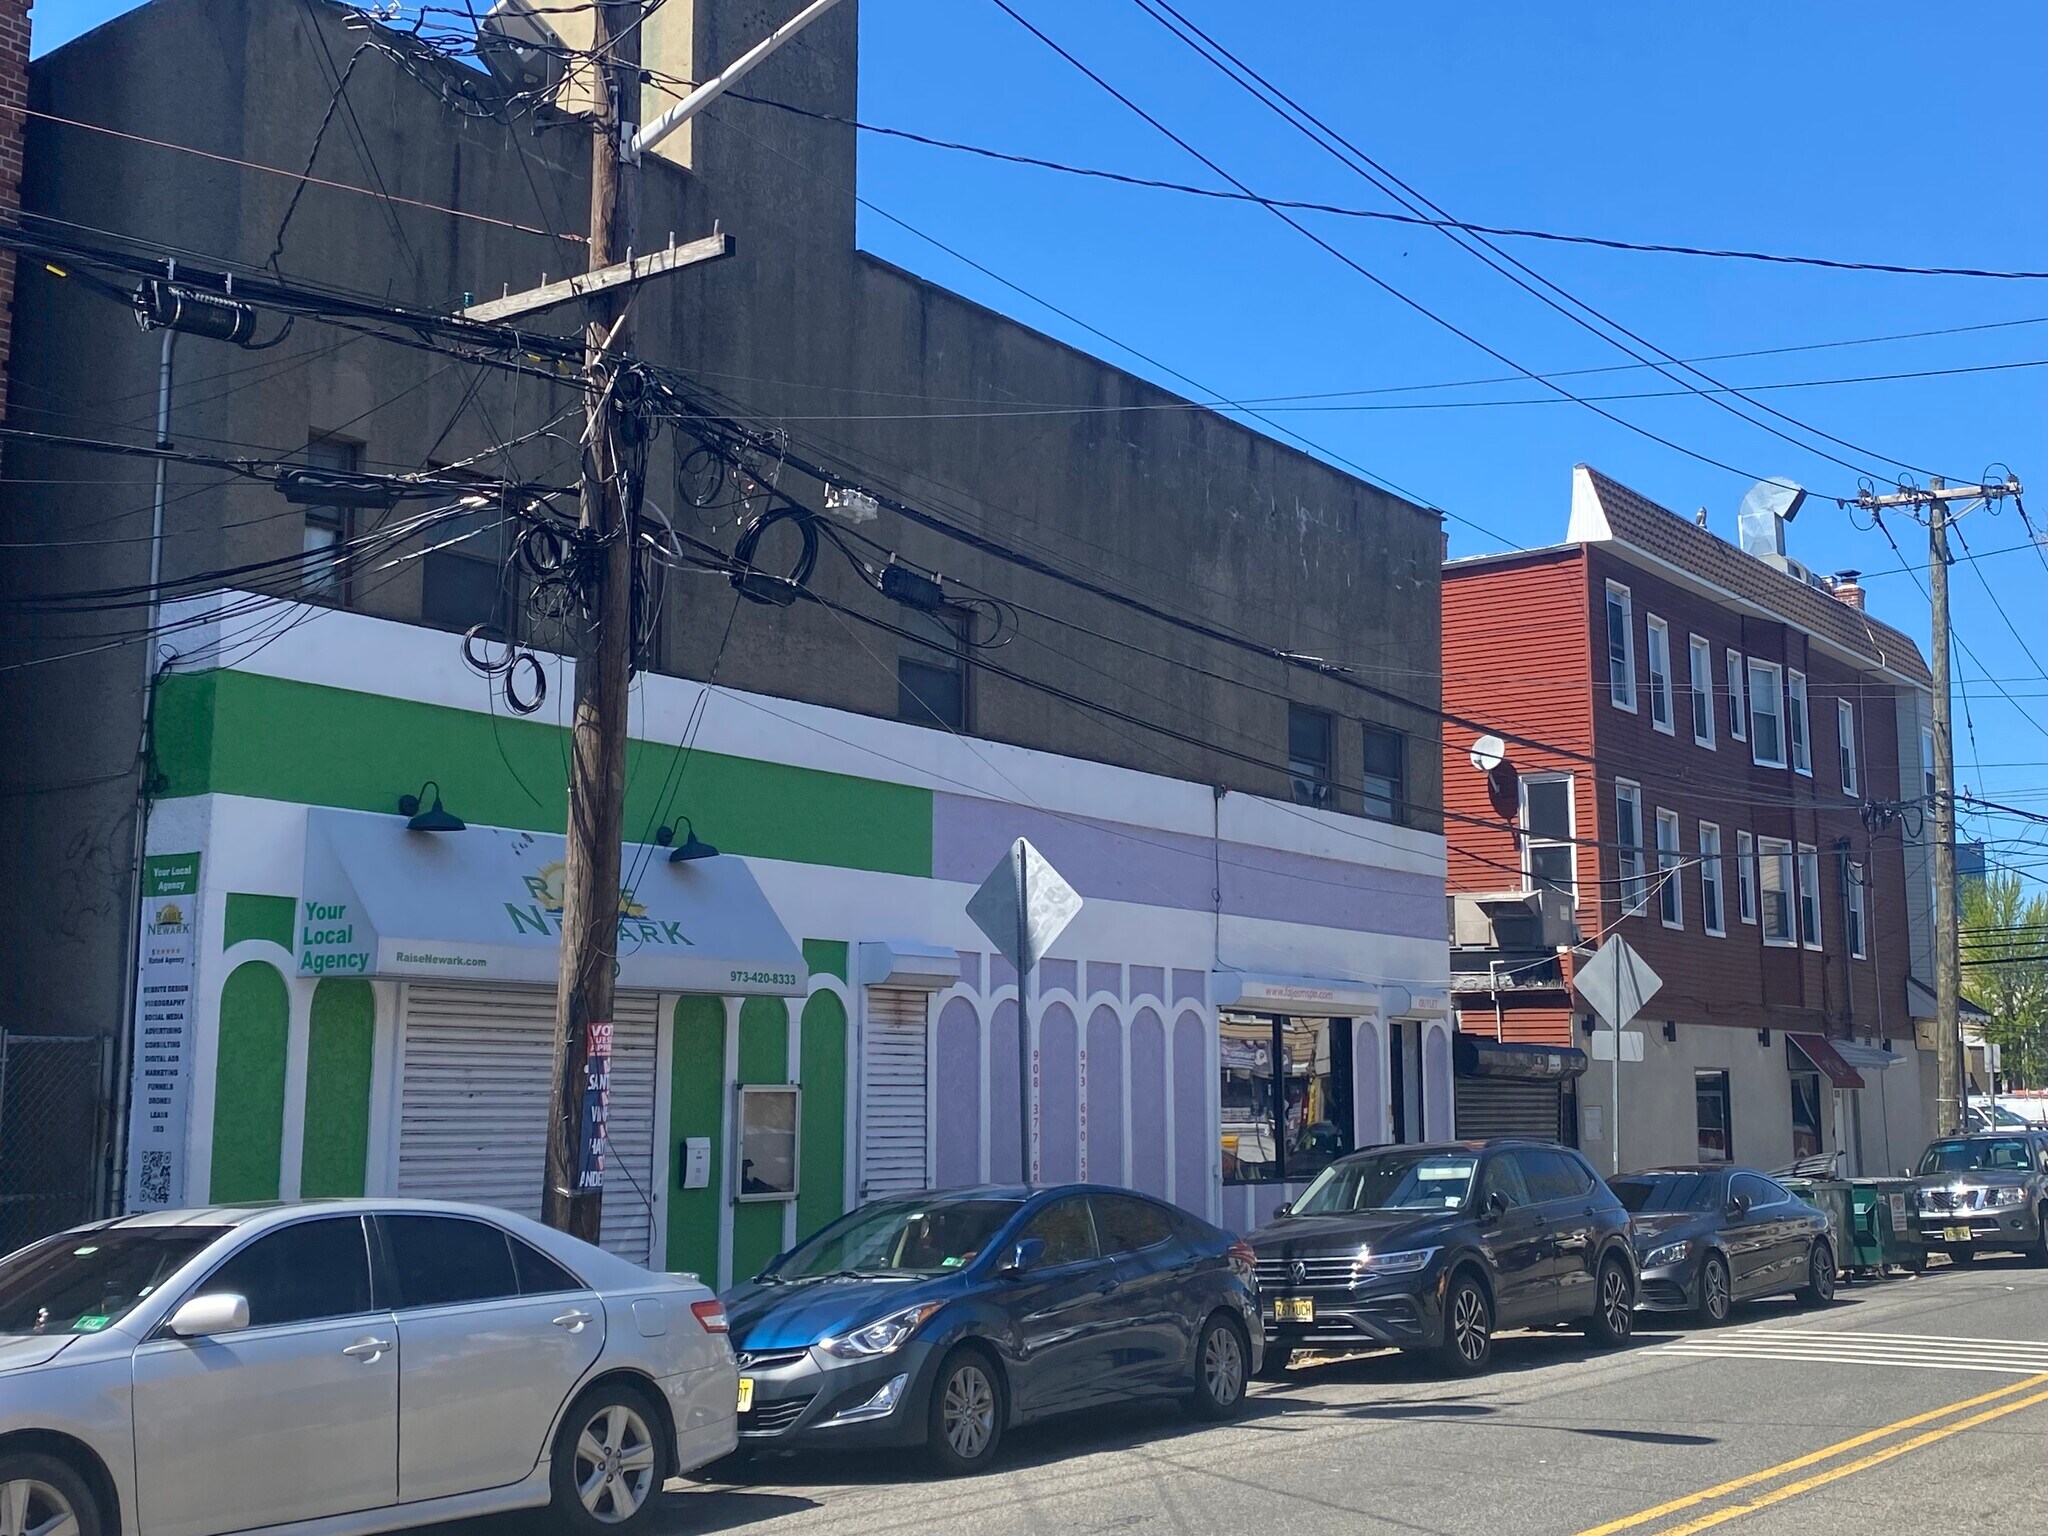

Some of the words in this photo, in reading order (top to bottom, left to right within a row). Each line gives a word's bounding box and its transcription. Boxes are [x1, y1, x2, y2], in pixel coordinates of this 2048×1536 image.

[154, 868, 169, 878] Your
[172, 866, 192, 876] Local
[158, 881, 186, 892] Agency
[305, 902, 346, 921] Your
[147, 923, 190, 937] NEWARK
[503, 902, 695, 946] NARK
[303, 924, 352, 946] Local
[148, 957, 164, 965] Rated
[165, 956, 185, 966] Agency
[300, 951, 370, 974] Agency
[396, 952, 487, 967] RaiseNewark.com
[730, 970, 796, 985] 973-420-8333
[145, 999, 186, 1007] VIDEOGRAPHY
[1418, 999, 1438, 1009] OUTLET
[144, 1027, 182, 1035] ADVERTISING
